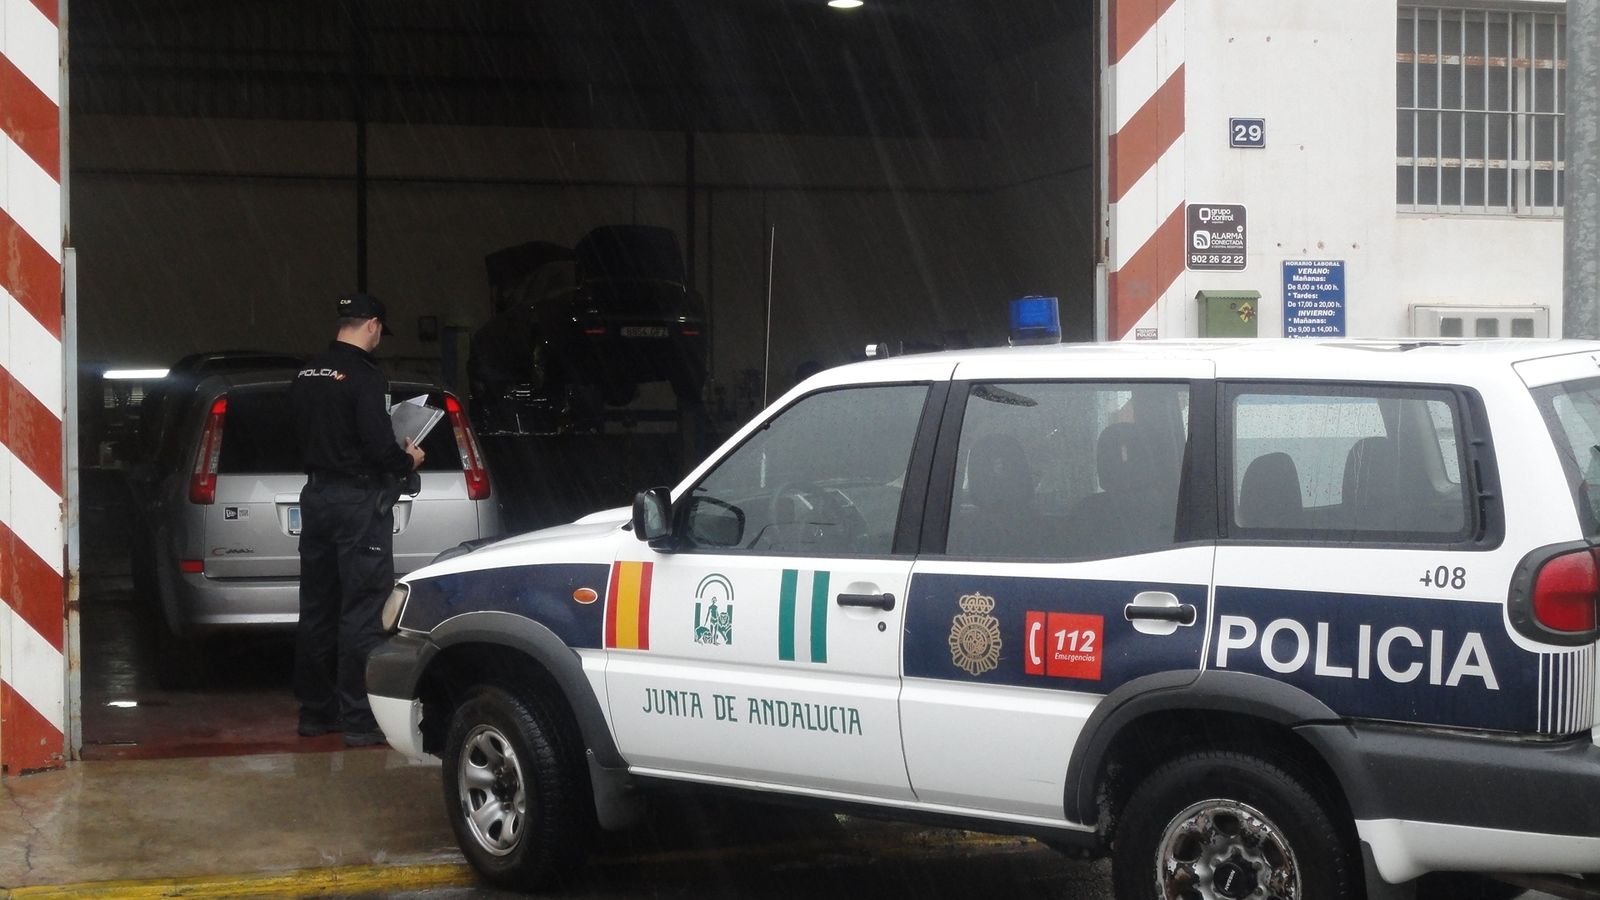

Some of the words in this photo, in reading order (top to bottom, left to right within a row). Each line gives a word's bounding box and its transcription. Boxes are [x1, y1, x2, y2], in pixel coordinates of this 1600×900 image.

[1234, 124, 1262, 141] 29
[1192, 255, 1207, 264] 902
[1209, 255, 1220, 264] 26
[1222, 256, 1232, 264] 22
[1234, 256, 1244, 264] 22
[1054, 629, 1096, 652] 112
[1054, 652, 1096, 662] Emergencias
[1216, 615, 1500, 690] POLICIA
[642, 688, 703, 718] JUNTA
[713, 694, 738, 722] DE
[748, 698, 862, 736] ANDALUCIA
